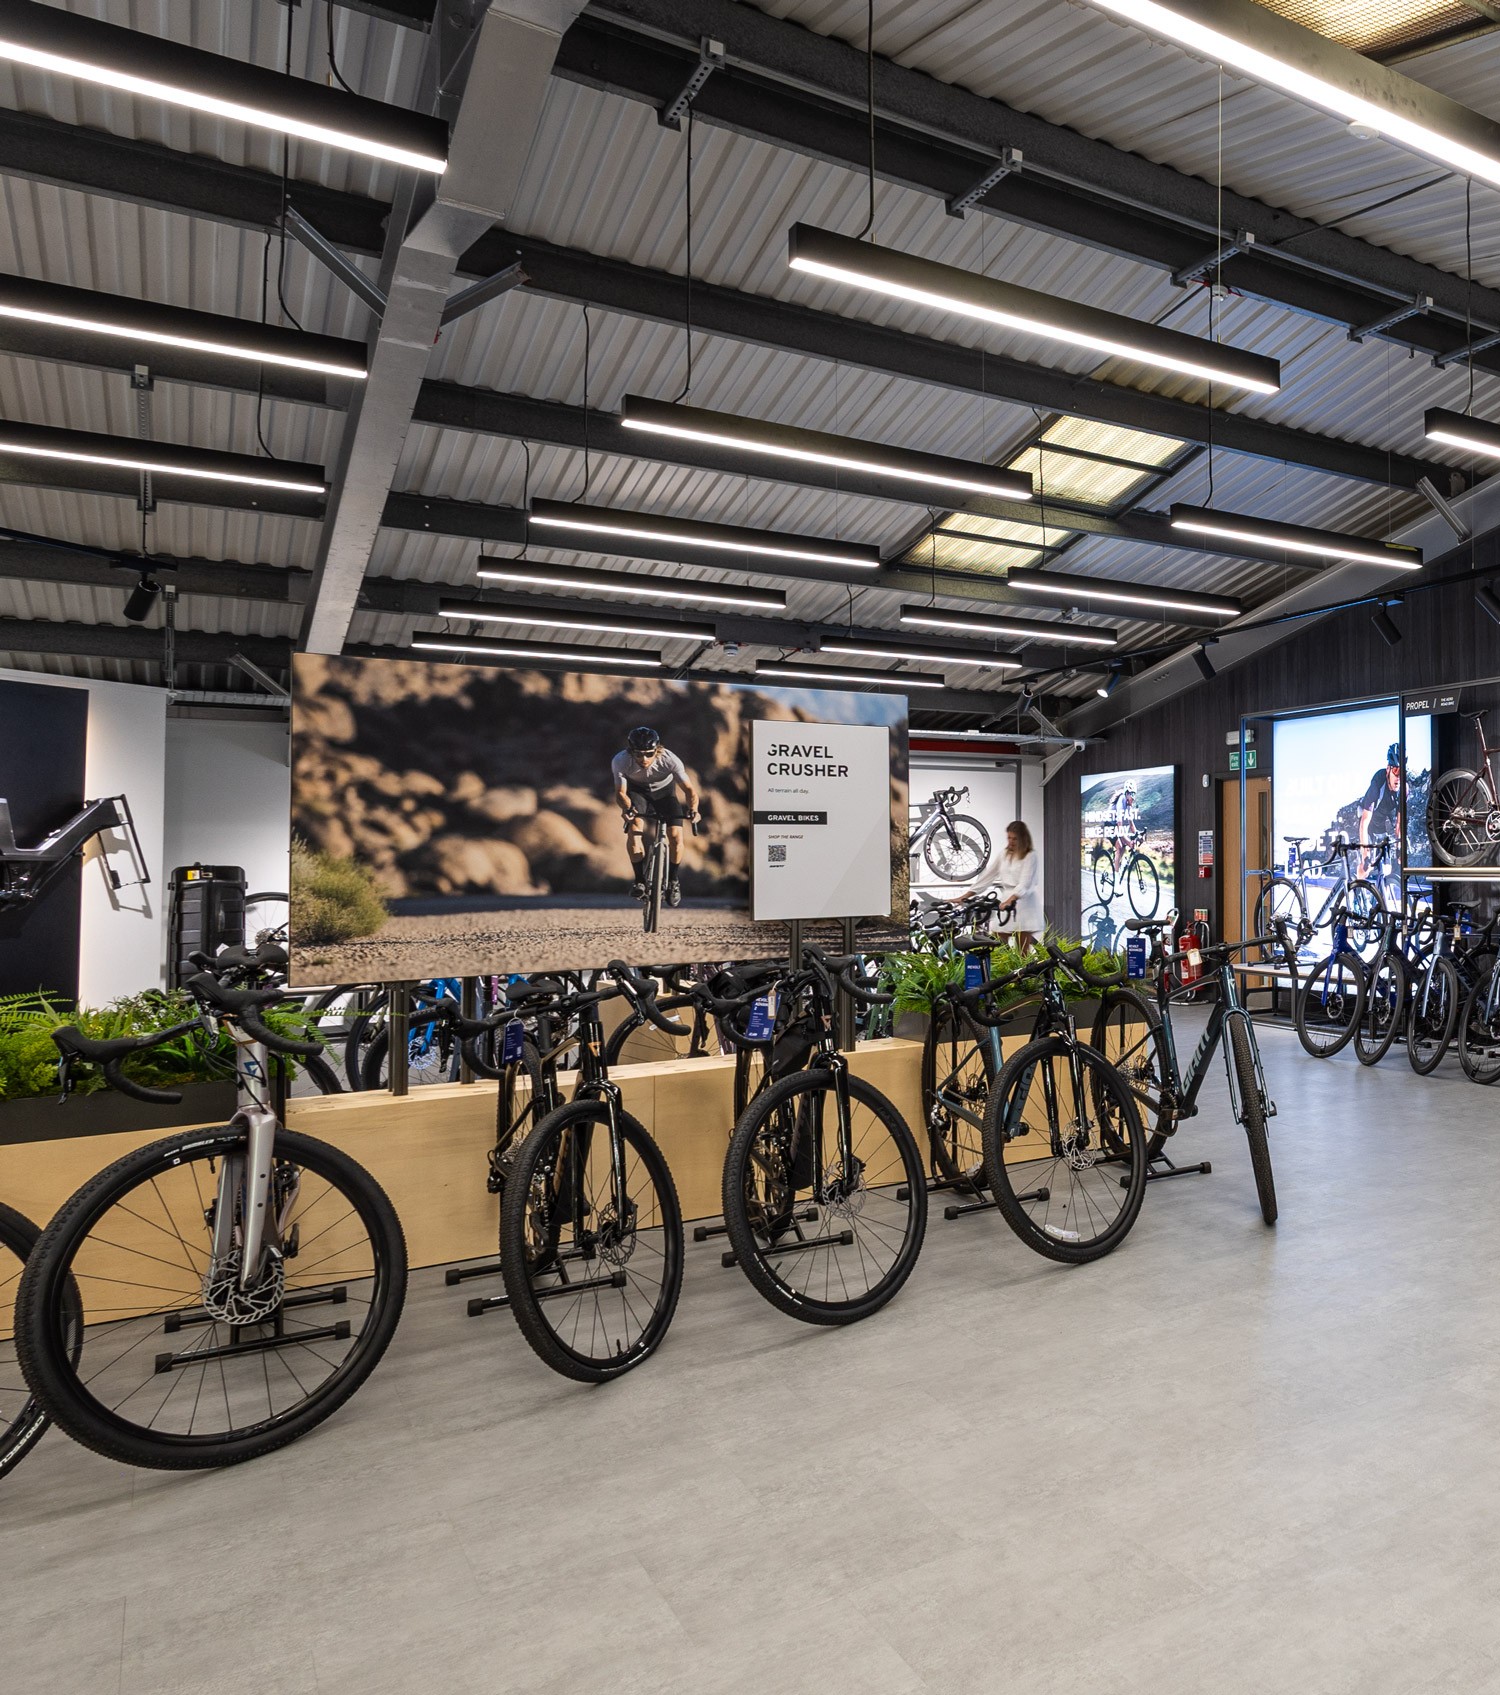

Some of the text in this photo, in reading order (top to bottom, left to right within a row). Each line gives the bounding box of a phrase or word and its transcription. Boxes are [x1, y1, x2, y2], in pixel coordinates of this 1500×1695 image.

[1405, 700, 1430, 710] PROPEL
[767, 744, 833, 758] GRAVEL
[767, 763, 848, 777] CRUSHER
[1181, 1028, 1210, 1097] GIANT
